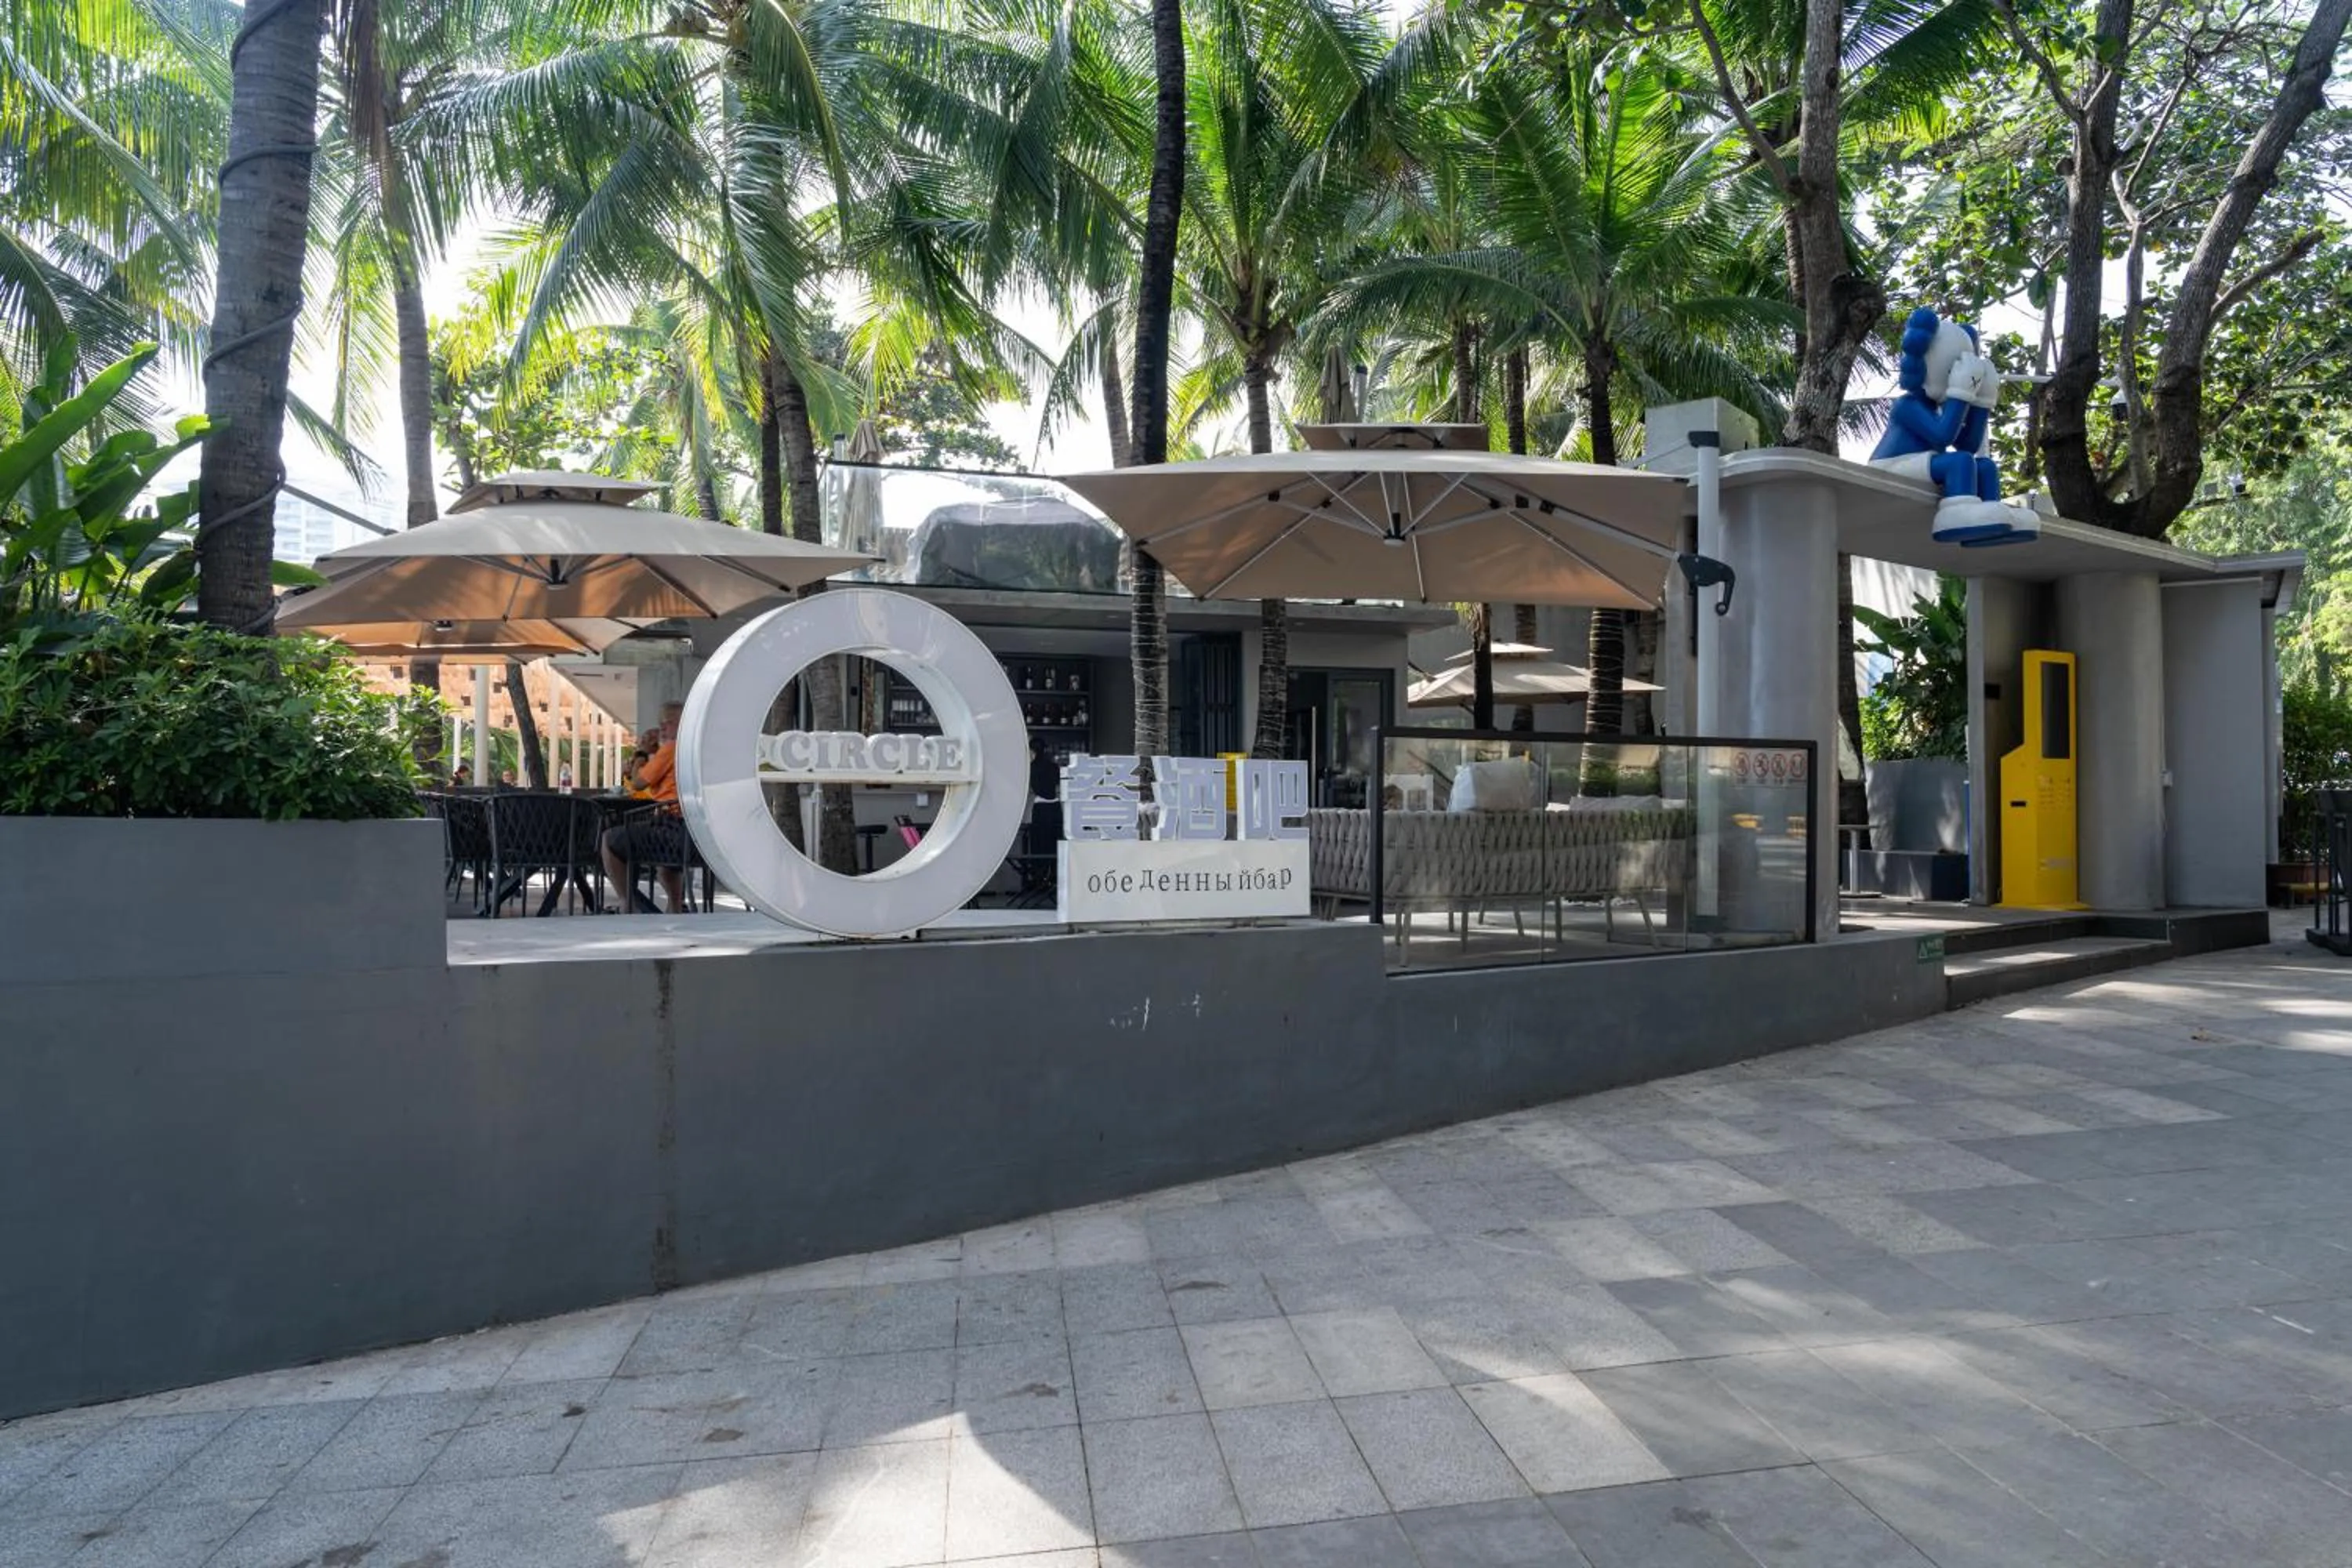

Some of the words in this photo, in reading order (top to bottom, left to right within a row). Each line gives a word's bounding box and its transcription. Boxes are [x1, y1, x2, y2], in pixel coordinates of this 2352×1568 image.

[779, 733, 964, 771] CIRCLE
[1060, 753, 1308, 840] 餐酒吧
